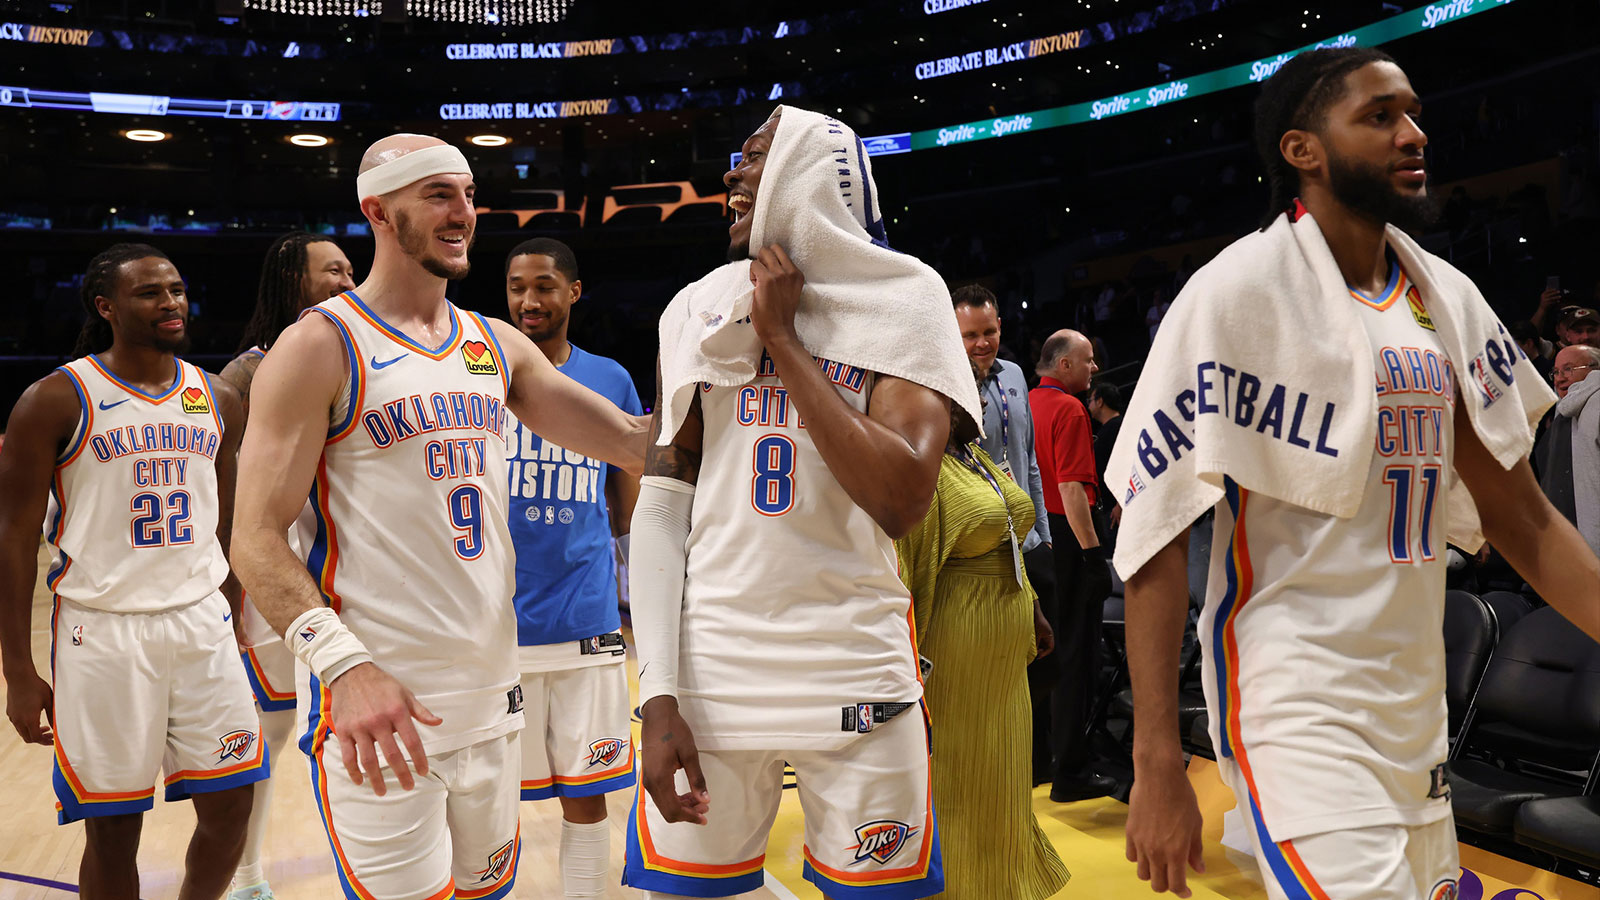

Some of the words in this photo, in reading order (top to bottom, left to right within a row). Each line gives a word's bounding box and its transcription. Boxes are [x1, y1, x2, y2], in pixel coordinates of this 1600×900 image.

[1422, 0, 1474, 28] Sprite
[27, 25, 94, 46] HISTORY
[446, 43, 518, 60] CELEBRATE
[521, 42, 562, 59] BLACK
[564, 38, 616, 58] HISTORY
[915, 51, 983, 80] CELEBRATE
[985, 42, 1025, 67] BLACK
[1028, 29, 1084, 57] HISTORY
[440, 103, 513, 120] CELEBRATE
[515, 102, 557, 119] BLACK
[559, 98, 612, 117] HISTORY
[1090, 96, 1130, 120] Sprite
[1146, 81, 1189, 107] Sprite
[936, 124, 976, 146] Sprite
[991, 114, 1032, 137] Sprite
[736, 386, 806, 429] CIT
[1137, 361, 1339, 479] BASETBALL
[90, 423, 219, 463] OKLAHOMA
[1376, 406, 1444, 457] CITY
[133, 457, 189, 487] CITY
[424, 438, 486, 481] CITY
[751, 433, 797, 517] 8
[510, 461, 599, 503] ISTORY
[130, 490, 195, 549] 22
[447, 484, 486, 561] 9
[1383, 464, 1442, 564] 11
[856, 828, 897, 859] OKC
